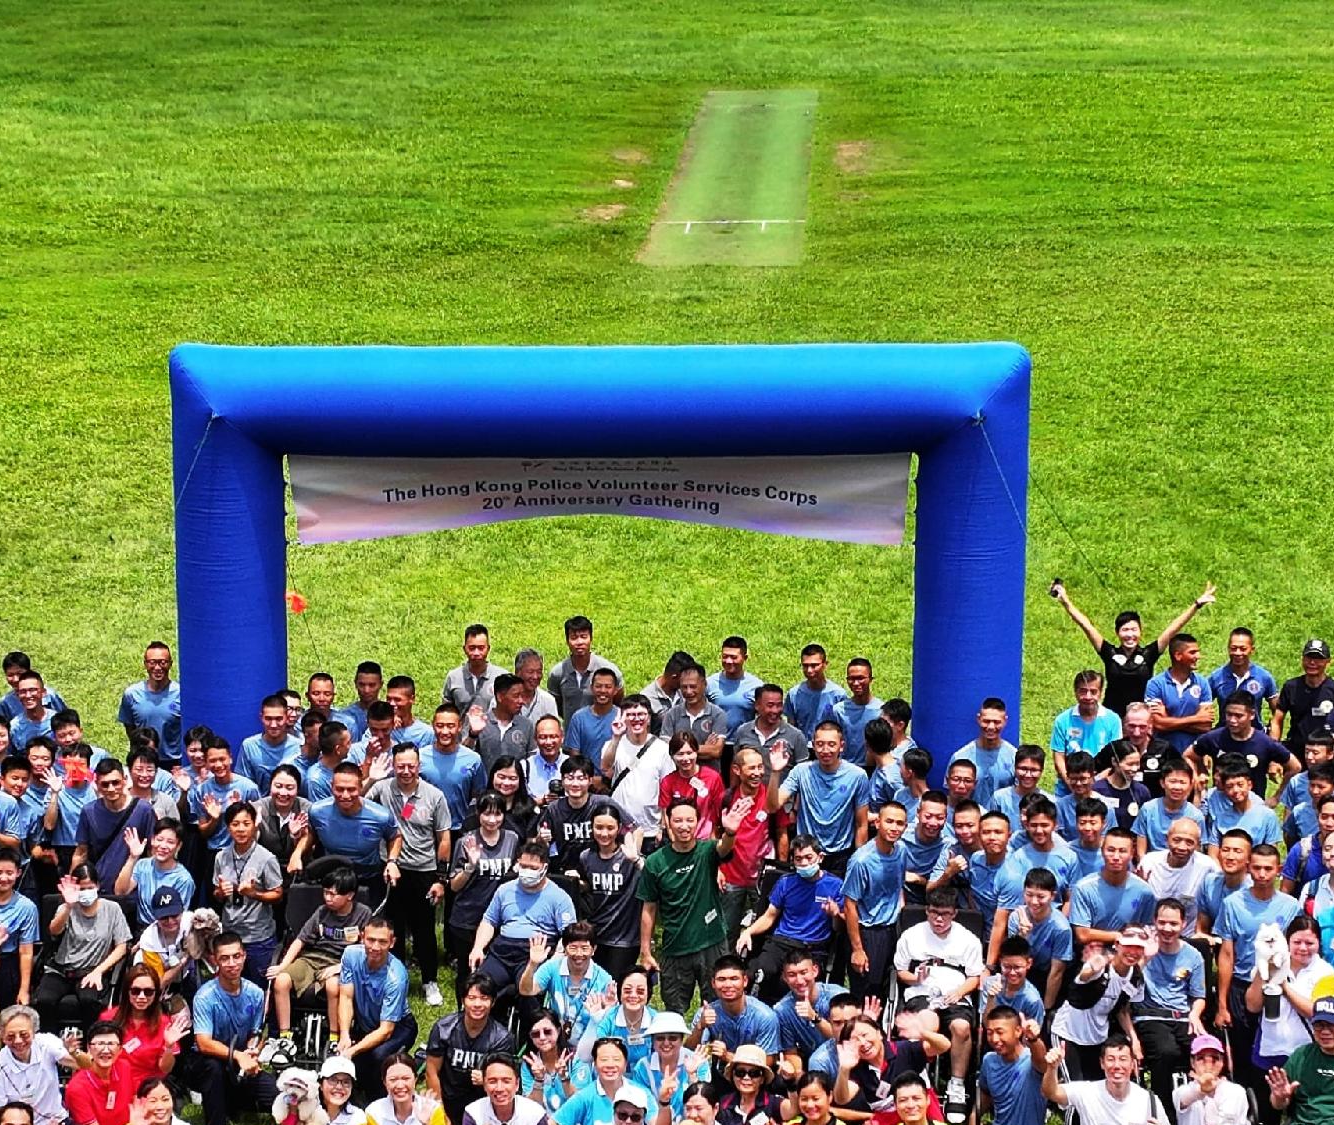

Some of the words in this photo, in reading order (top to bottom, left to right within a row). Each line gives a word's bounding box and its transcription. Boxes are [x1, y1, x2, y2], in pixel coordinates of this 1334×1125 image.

[383, 488, 416, 503] The
[422, 483, 470, 497] Hong
[475, 480, 523, 493] Kong
[528, 479, 583, 490] Police
[587, 479, 679, 491] Volunteer
[683, 480, 760, 497] Services
[765, 486, 818, 505] Corps
[514, 494, 624, 508] Anniversary
[629, 494, 720, 515] Gathering
[592, 872, 623, 891] PMP
